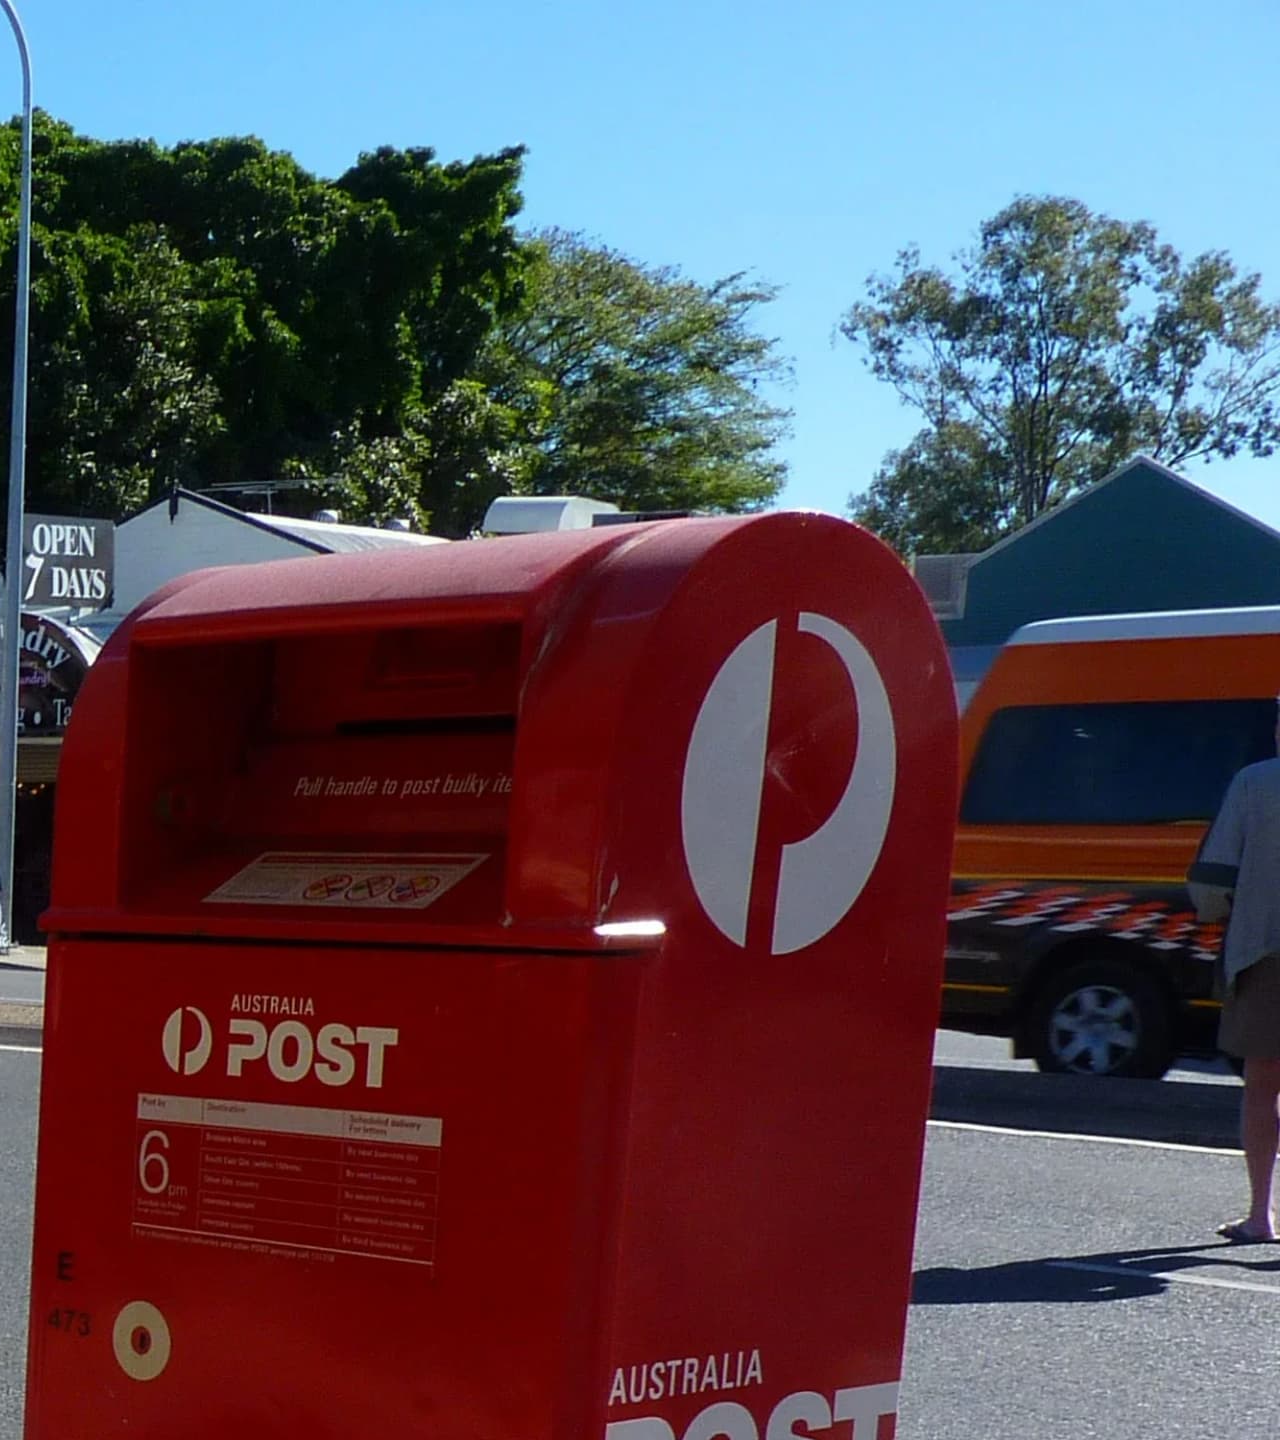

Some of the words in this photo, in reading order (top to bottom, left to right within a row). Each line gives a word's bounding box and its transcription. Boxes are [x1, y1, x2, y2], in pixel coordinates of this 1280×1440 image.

[32, 523, 97, 557] OPEN
[25, 553, 45, 600] 7
[51, 566, 107, 599] DAYS
[294, 776, 324, 798] Pull
[324, 775, 378, 797] handle
[381, 777, 396, 796] to
[399, 777, 441, 800] post
[442, 773, 489, 798] bulky
[230, 994, 315, 1017] AUSTRALIA
[226, 1018, 399, 1089] POST
[139, 1129, 170, 1194] 6
[168, 1184, 189, 1197] pm
[57, 1251, 75, 1282] E
[47, 1306, 92, 1337] 473
[608, 1349, 764, 1407] AUSTRALIA
